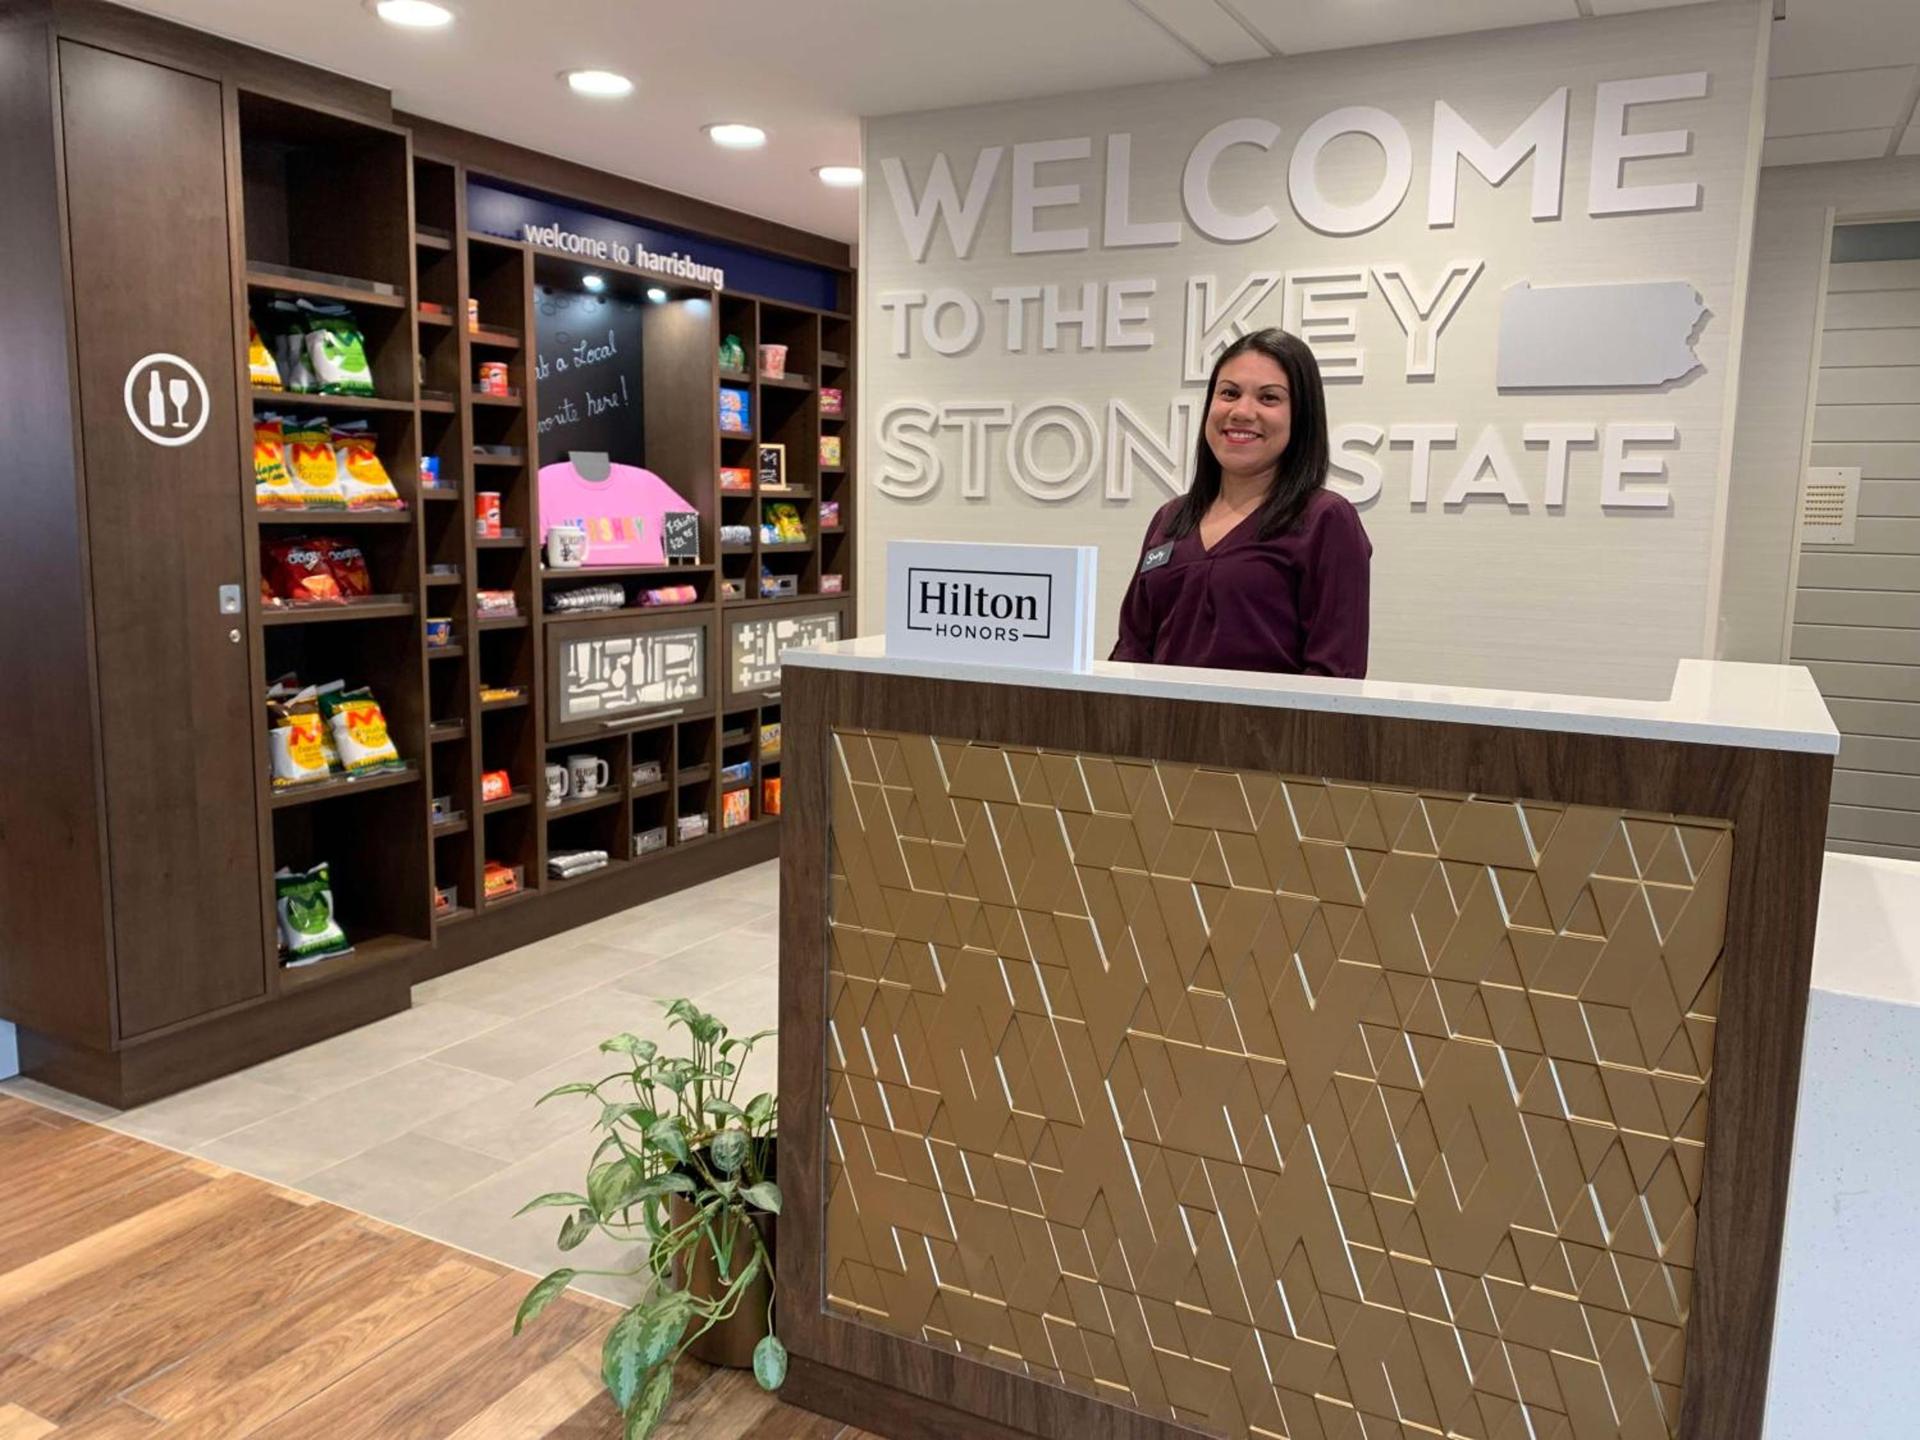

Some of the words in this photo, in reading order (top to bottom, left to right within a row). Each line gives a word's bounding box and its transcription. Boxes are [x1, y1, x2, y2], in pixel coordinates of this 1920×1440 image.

[880, 71, 1708, 262] WELCOME
[524, 223, 607, 260] welcome
[612, 240, 630, 265] to
[636, 243, 724, 290] harrisburg
[572, 329, 617, 368] Local
[880, 290, 980, 357] TO
[993, 279, 1157, 352] THE
[1184, 259, 1485, 383] KEY
[875, 400, 1200, 502] STON
[1325, 424, 1679, 509] STATE
[919, 580, 1039, 621] Hilton
[935, 623, 1019, 642] HONORS
